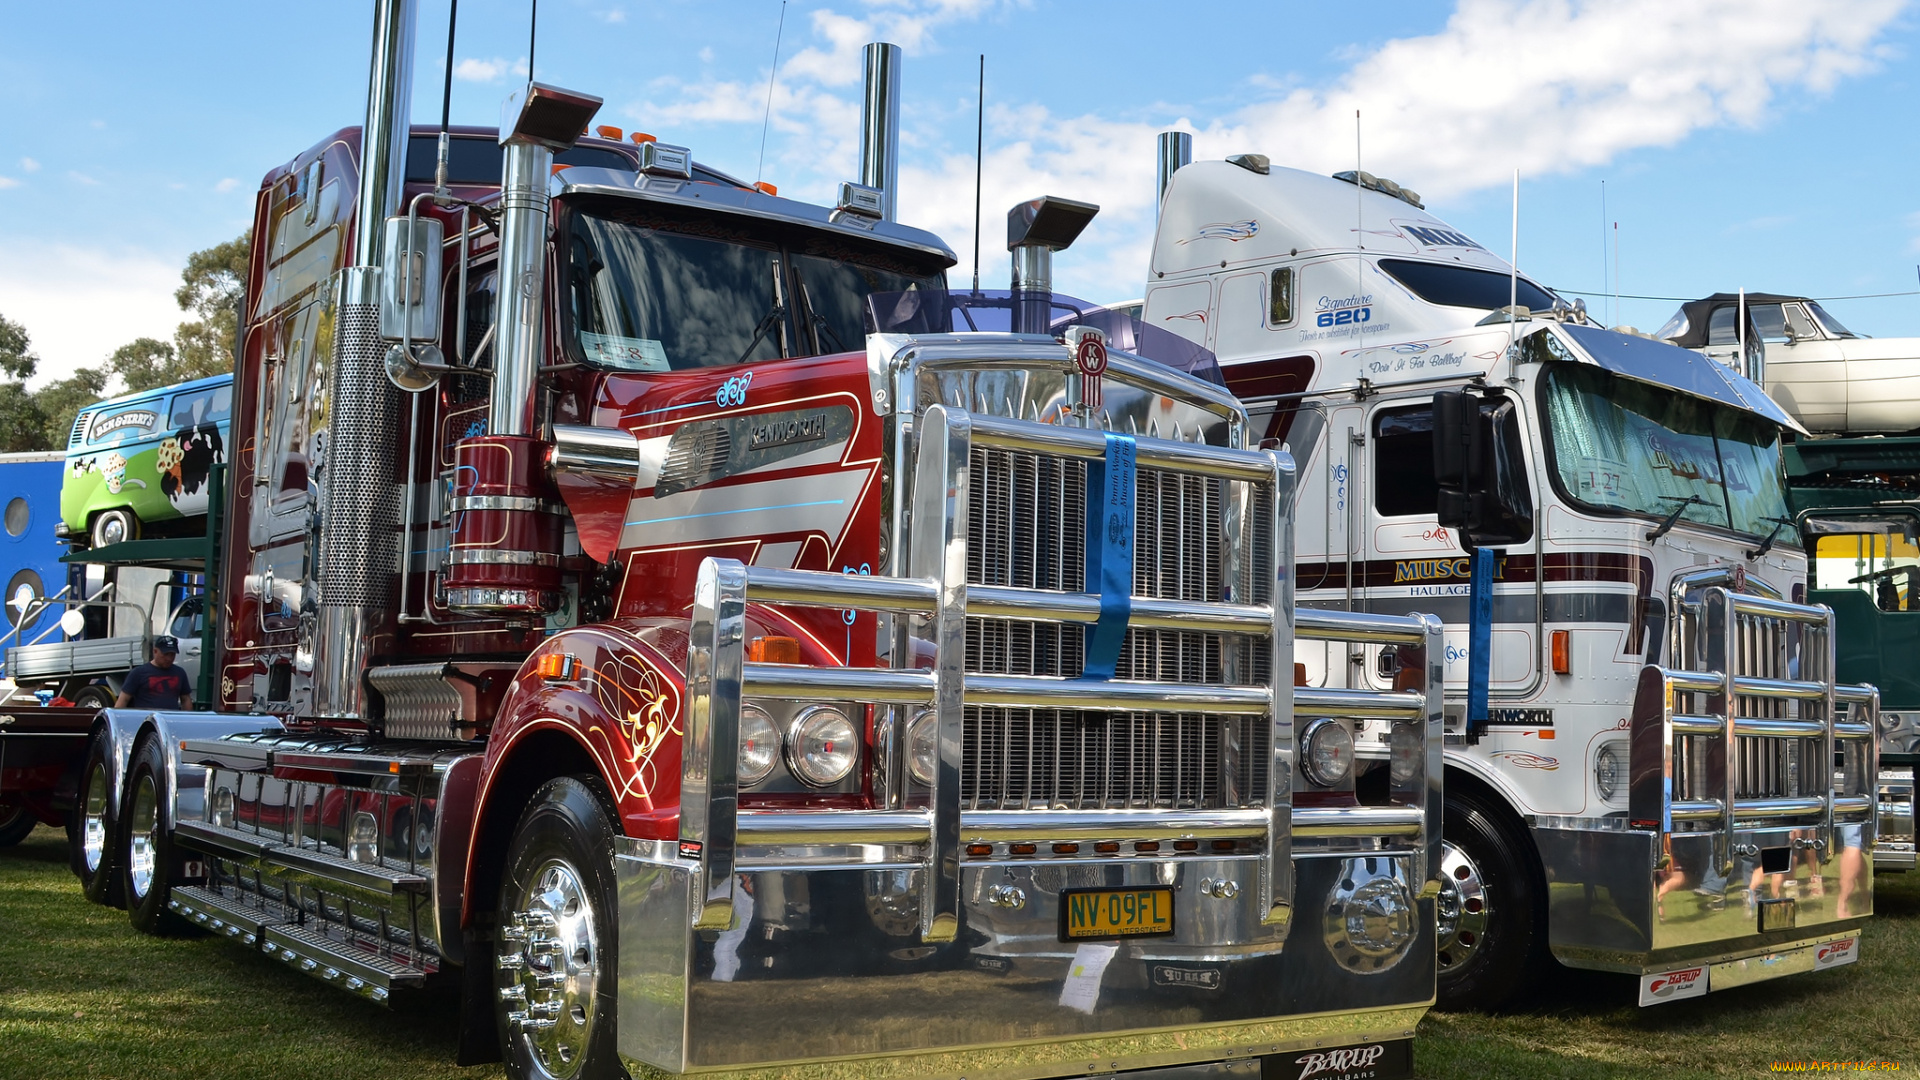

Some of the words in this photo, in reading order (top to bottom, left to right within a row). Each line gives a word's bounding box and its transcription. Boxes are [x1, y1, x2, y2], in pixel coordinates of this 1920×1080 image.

[1316, 294, 1373, 313] Signature
[1317, 307, 1371, 328] 620
[750, 414, 827, 445] KENWORTH
[1124, 458, 1132, 468] of
[1111, 474, 1119, 506] Penrith
[1120, 470, 1129, 507] Museum
[1394, 558, 1507, 582] MUSCT
[1410, 585, 1471, 596] HAULAGE
[1488, 709, 1553, 722] ENWORTH
[1313, 1070, 1376, 1080] LLBARS
